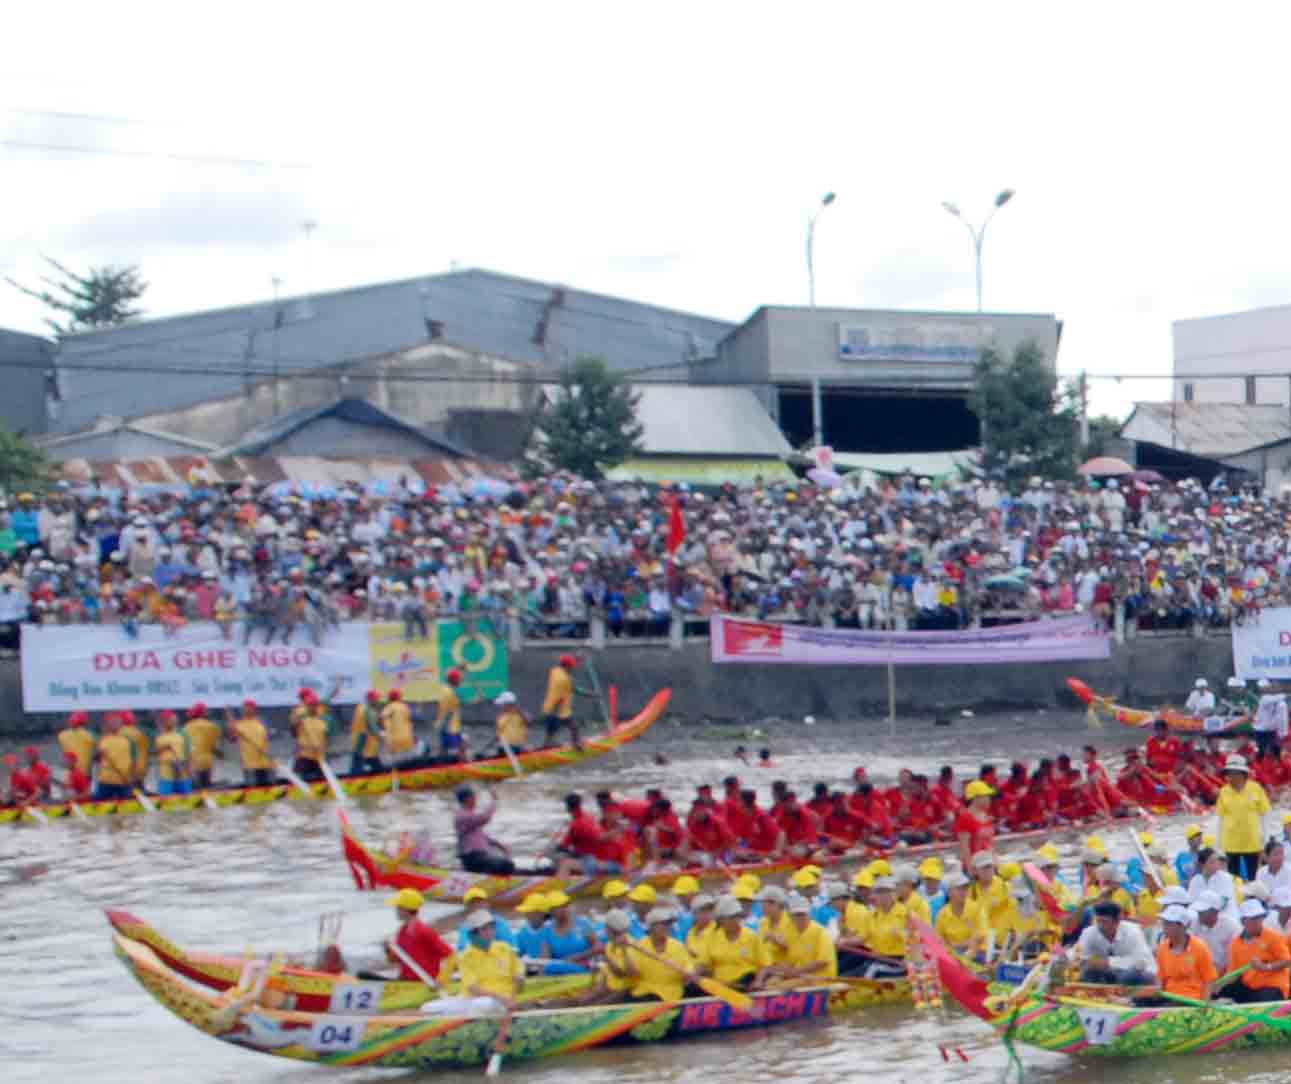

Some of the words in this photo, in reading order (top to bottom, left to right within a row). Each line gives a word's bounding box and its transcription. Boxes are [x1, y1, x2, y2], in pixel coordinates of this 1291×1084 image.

[173, 650, 237, 670] GHE
[248, 648, 313, 668] NGO
[343, 991, 372, 1009] 12
[320, 1025, 352, 1045] 04
